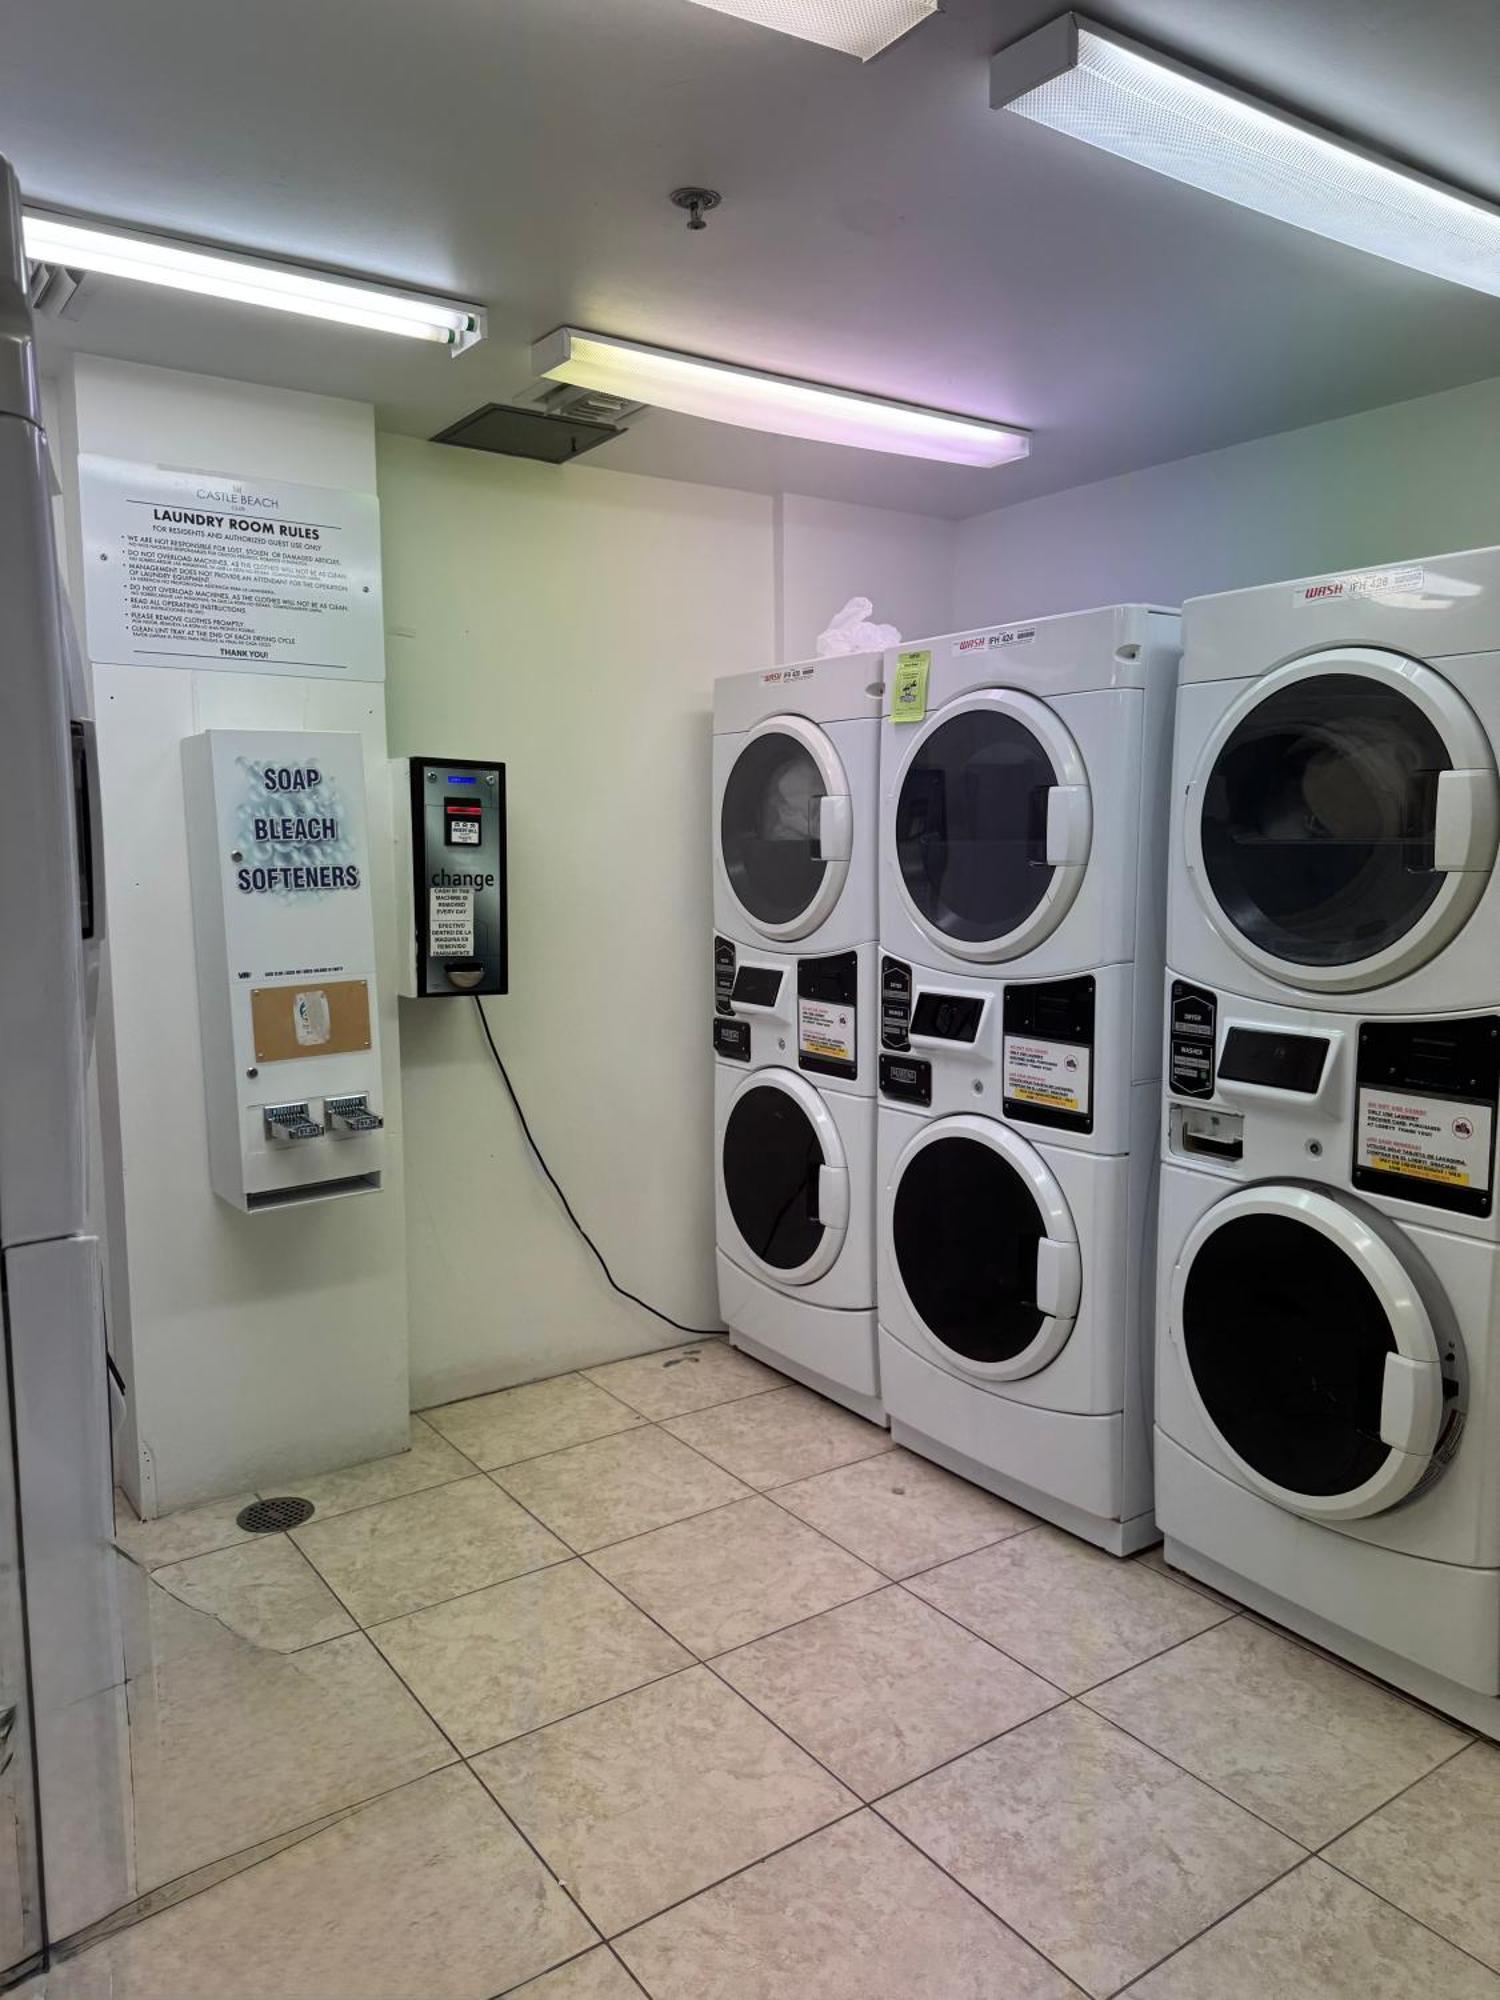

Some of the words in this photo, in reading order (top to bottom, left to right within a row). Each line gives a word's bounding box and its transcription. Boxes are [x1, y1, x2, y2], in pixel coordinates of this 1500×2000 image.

[196, 488, 238, 504] CASTLE
[240, 494, 279, 509] BEACH
[153, 508, 224, 528] LAUNDRY
[228, 518, 274, 534] ROOM
[279, 524, 319, 540] RULES
[139, 535, 152, 543] ARE
[154, 537, 168, 545] NOT
[213, 544, 225, 552] FOR
[152, 524, 166, 532] FOR
[168, 526, 204, 537] RESIDENTS
[207, 531, 222, 539] AND
[224, 533, 265, 544] AUTHORIZED
[267, 539, 288, 547] GUEST
[290, 541, 302, 549] USE
[303, 543, 320, 551] ONLY
[140, 550, 154, 558] NOT
[156, 552, 192, 562] OVERLOAD
[129, 562, 178, 573] MANAGEMENT
[140, 570, 170, 579] LAUNDRY
[158, 586, 193, 595] OVERLOAD
[1305, 583, 1344, 599] WASH
[162, 600, 198, 609] OPERATING
[131, 611, 152, 619] PLEASE
[155, 613, 182, 621] REMOVE
[184, 616, 211, 624] CLOTHES
[959, 637, 985, 650] WASH
[220, 648, 247, 656] THANK
[248, 650, 268, 658] YOU!
[264, 768, 320, 791] SOAP
[254, 817, 337, 841] BLEACH
[238, 865, 359, 892] SOFTENERS
[431, 868, 495, 892] change
[1183, 1013, 1202, 1022] DRYER
[1180, 1046, 1203, 1056] WASHER
